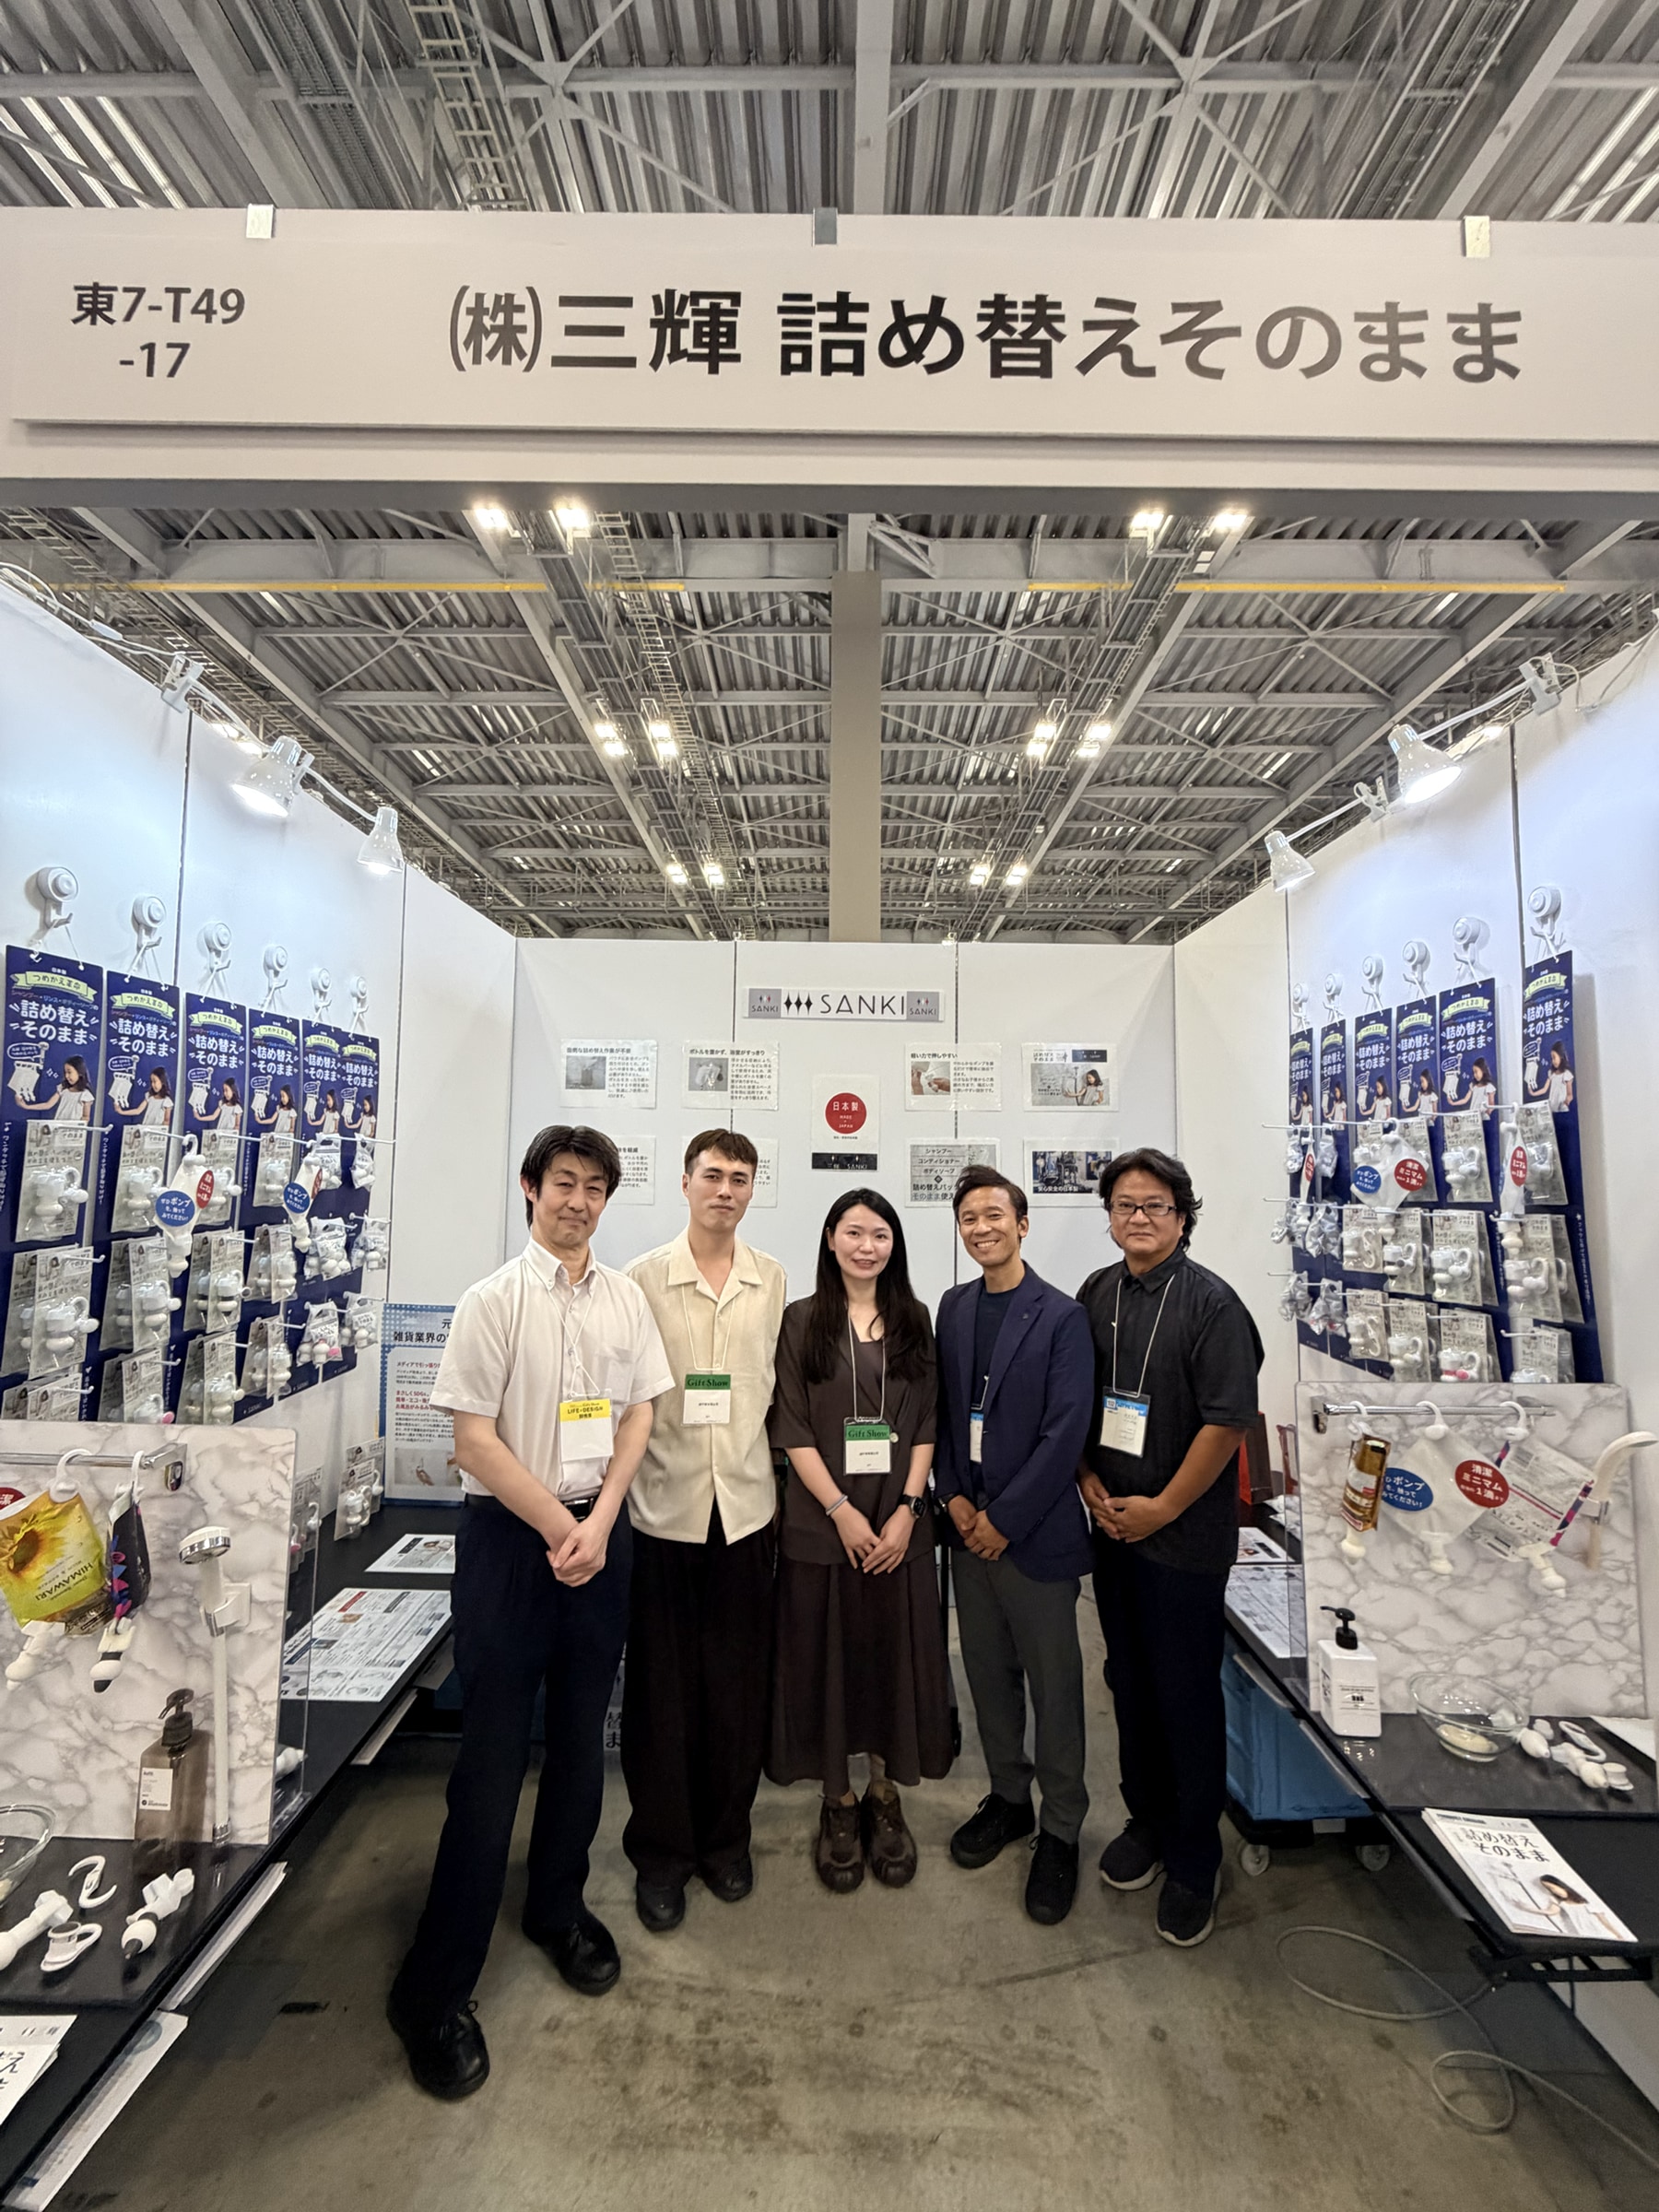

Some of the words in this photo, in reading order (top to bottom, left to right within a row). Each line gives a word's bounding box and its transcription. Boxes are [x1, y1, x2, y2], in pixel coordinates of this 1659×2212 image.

[72, 282, 244, 325] 東7-T49
[777, 291, 1521, 382] 詰め替えそのまま
[120, 343, 190, 377] -17
[20, 999, 89, 1027] 詰め替え
[751, 1005, 778, 1013] SANKI
[820, 994, 904, 1015] SANKI
[1527, 998, 1564, 1022] 詰め替え
[21, 1020, 88, 1044] そのまま
[118, 1018, 170, 1041] 詰め替え
[1446, 1019, 1487, 1040] 詰め替え
[1528, 1016, 1563, 1038] そのまま
[119, 1036, 169, 1057] そのまま
[195, 1034, 239, 1055] 詰め替え
[1359, 1042, 1386, 1059] 詰め替え
[1401, 1033, 1430, 1050] 詰め替え
[1447, 1035, 1486, 1053] そのまま
[195, 1050, 238, 1069] そのまま
[257, 1045, 294, 1064] 詰め替え
[309, 1053, 337, 1070] 詰め替え
[1359, 1057, 1385, 1071] そのまま
[1401, 1048, 1430, 1064] そのまま
[257, 1060, 293, 1077] そのまま
[309, 1067, 337, 1082] そのまま
[346, 1062, 375, 1077] 詰め替え
[346, 1076, 374, 1088] そのまま
[833, 1100, 858, 1112] 日本製
[394, 1332, 449, 1343] 雑貨業界の
[687, 1378, 705, 1387] Gift
[706, 1378, 728, 1387] Show
[848, 1430, 865, 1438] Gift
[866, 1430, 888, 1438] Show
[1472, 1464, 1492, 1477] 清潔
[1385, 1476, 1424, 1490] ひポンプ
[1463, 1473, 1503, 1492] ミニマム
[35, 1562, 93, 1601] HIMAWARI
[1473, 1841, 1550, 1862] そのまま
